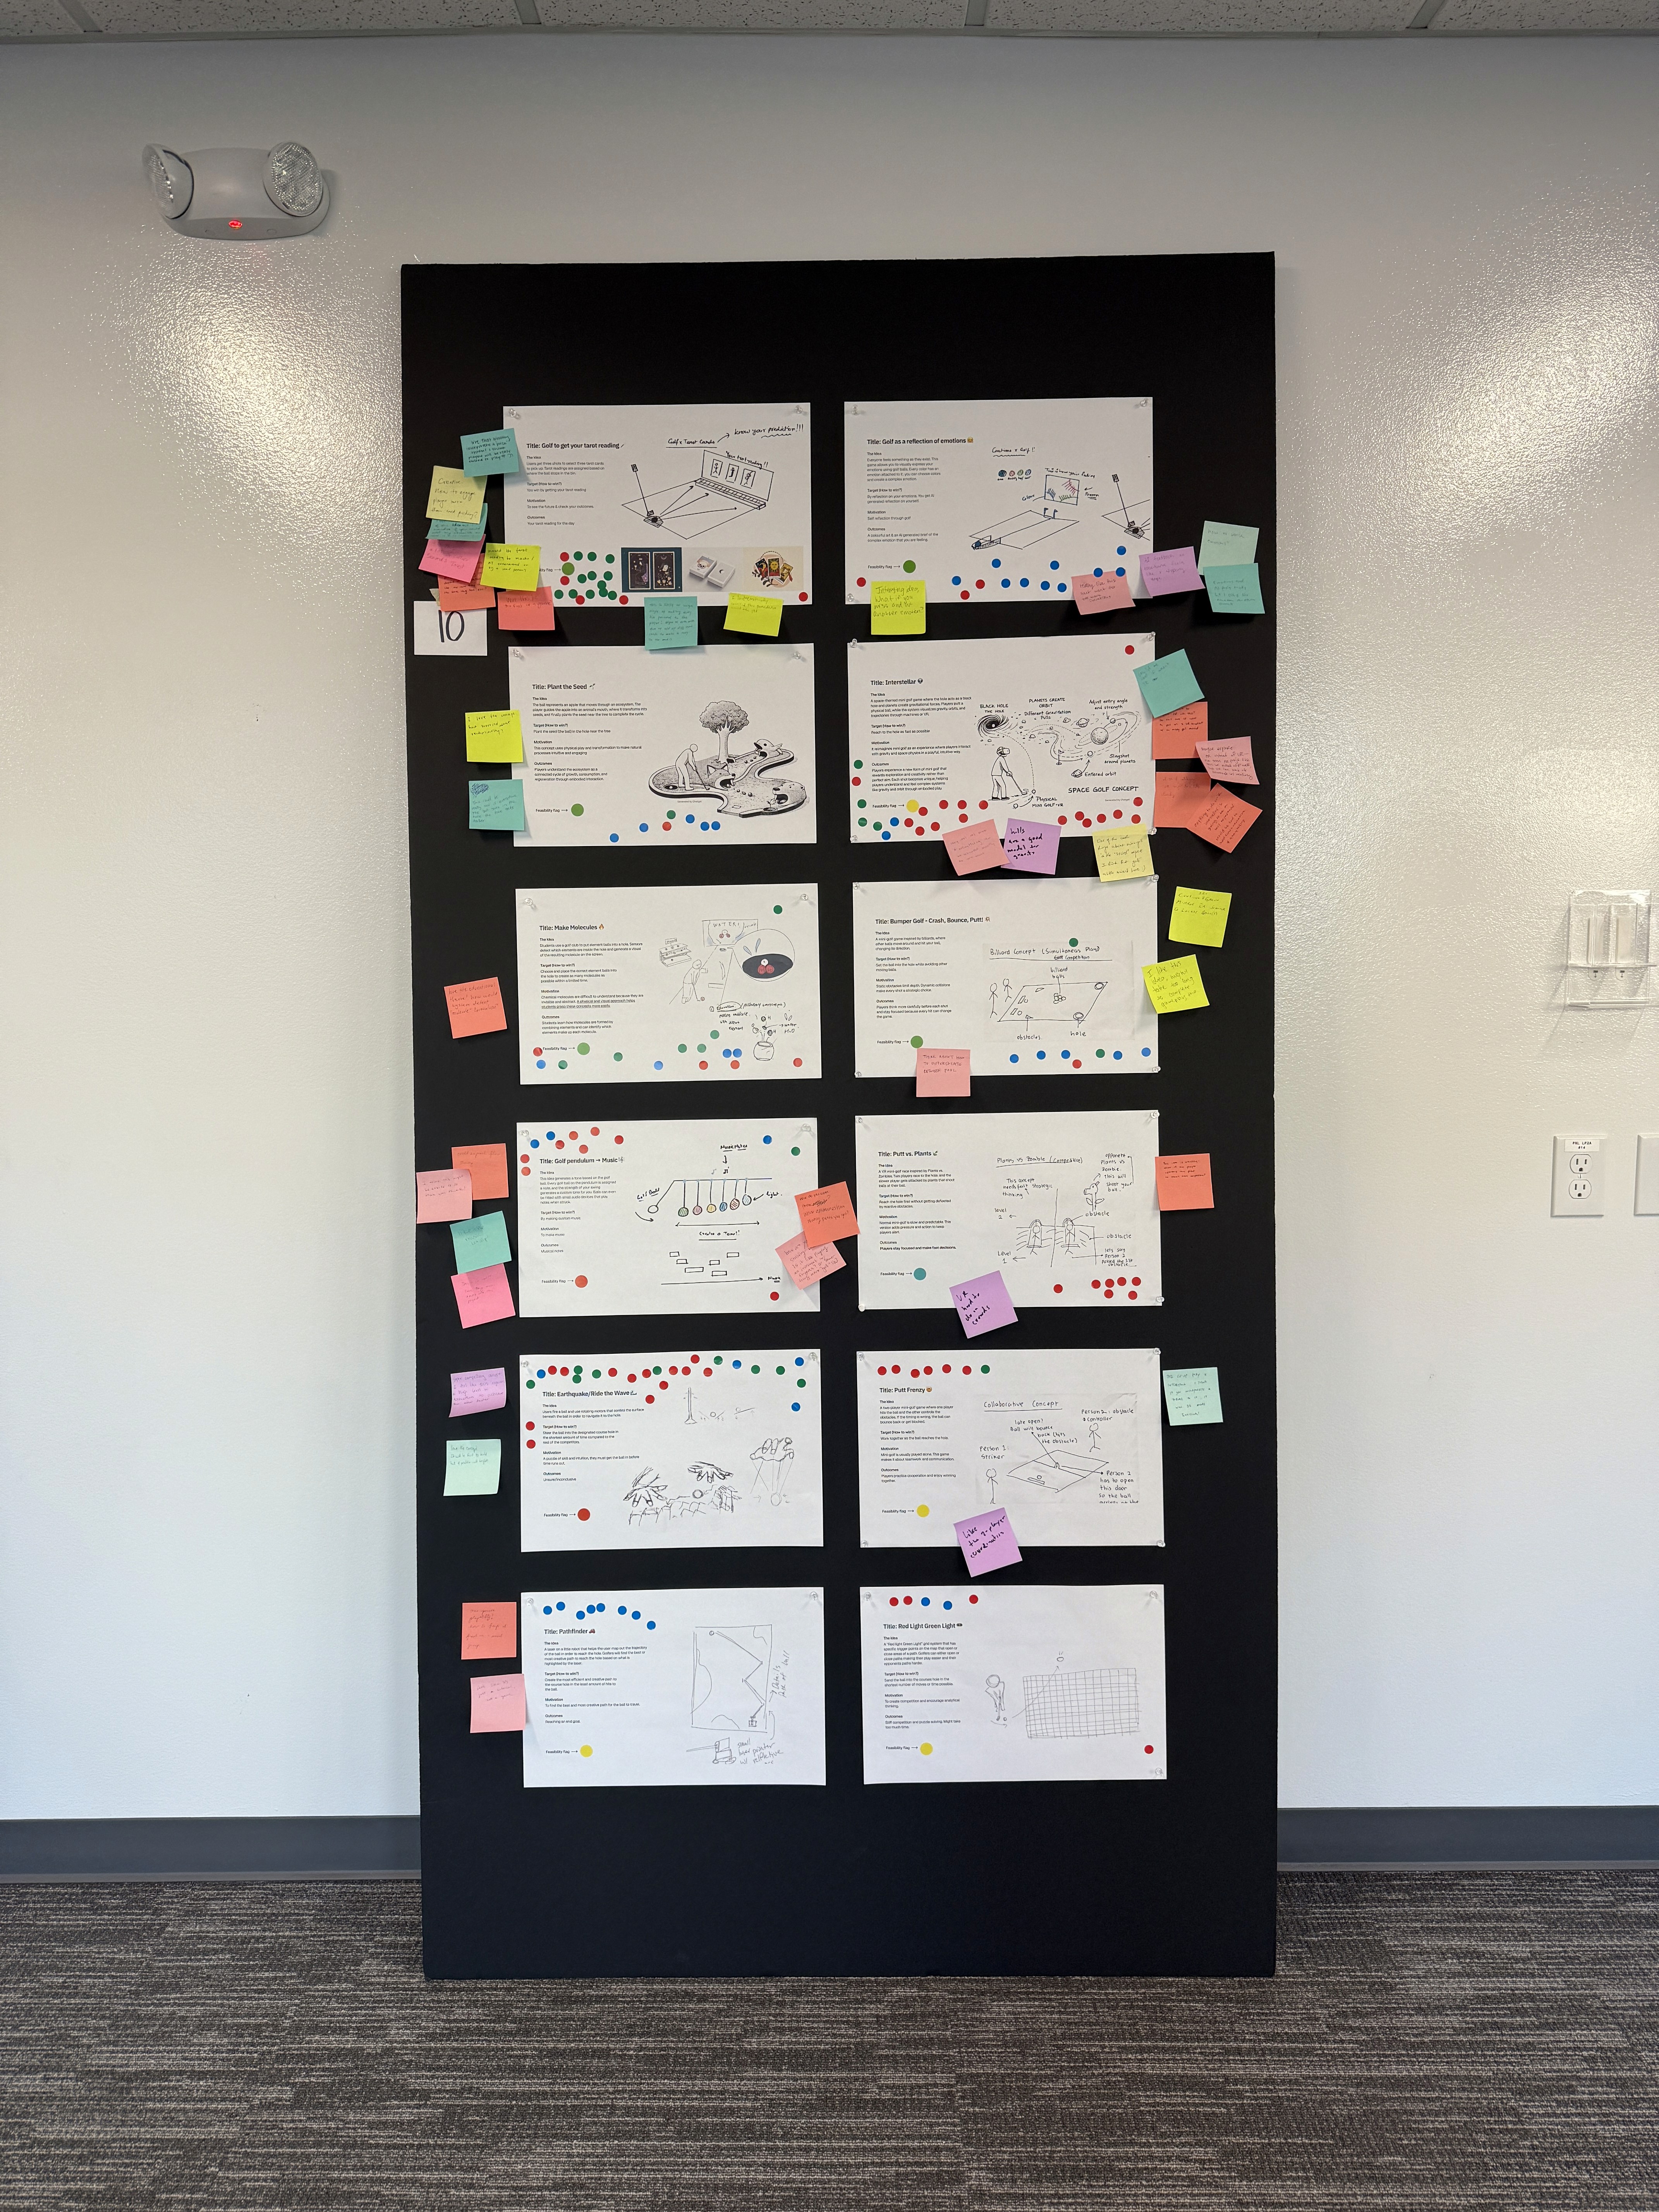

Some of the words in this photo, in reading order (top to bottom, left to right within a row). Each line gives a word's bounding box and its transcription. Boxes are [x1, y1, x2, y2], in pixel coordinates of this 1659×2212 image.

[438, 609, 465, 642] 10
[1028, 833, 1042, 842] good
[1007, 845, 1026, 853] model
[956, 1291, 968, 1301] VR
[962, 1527, 977, 1538] Like
